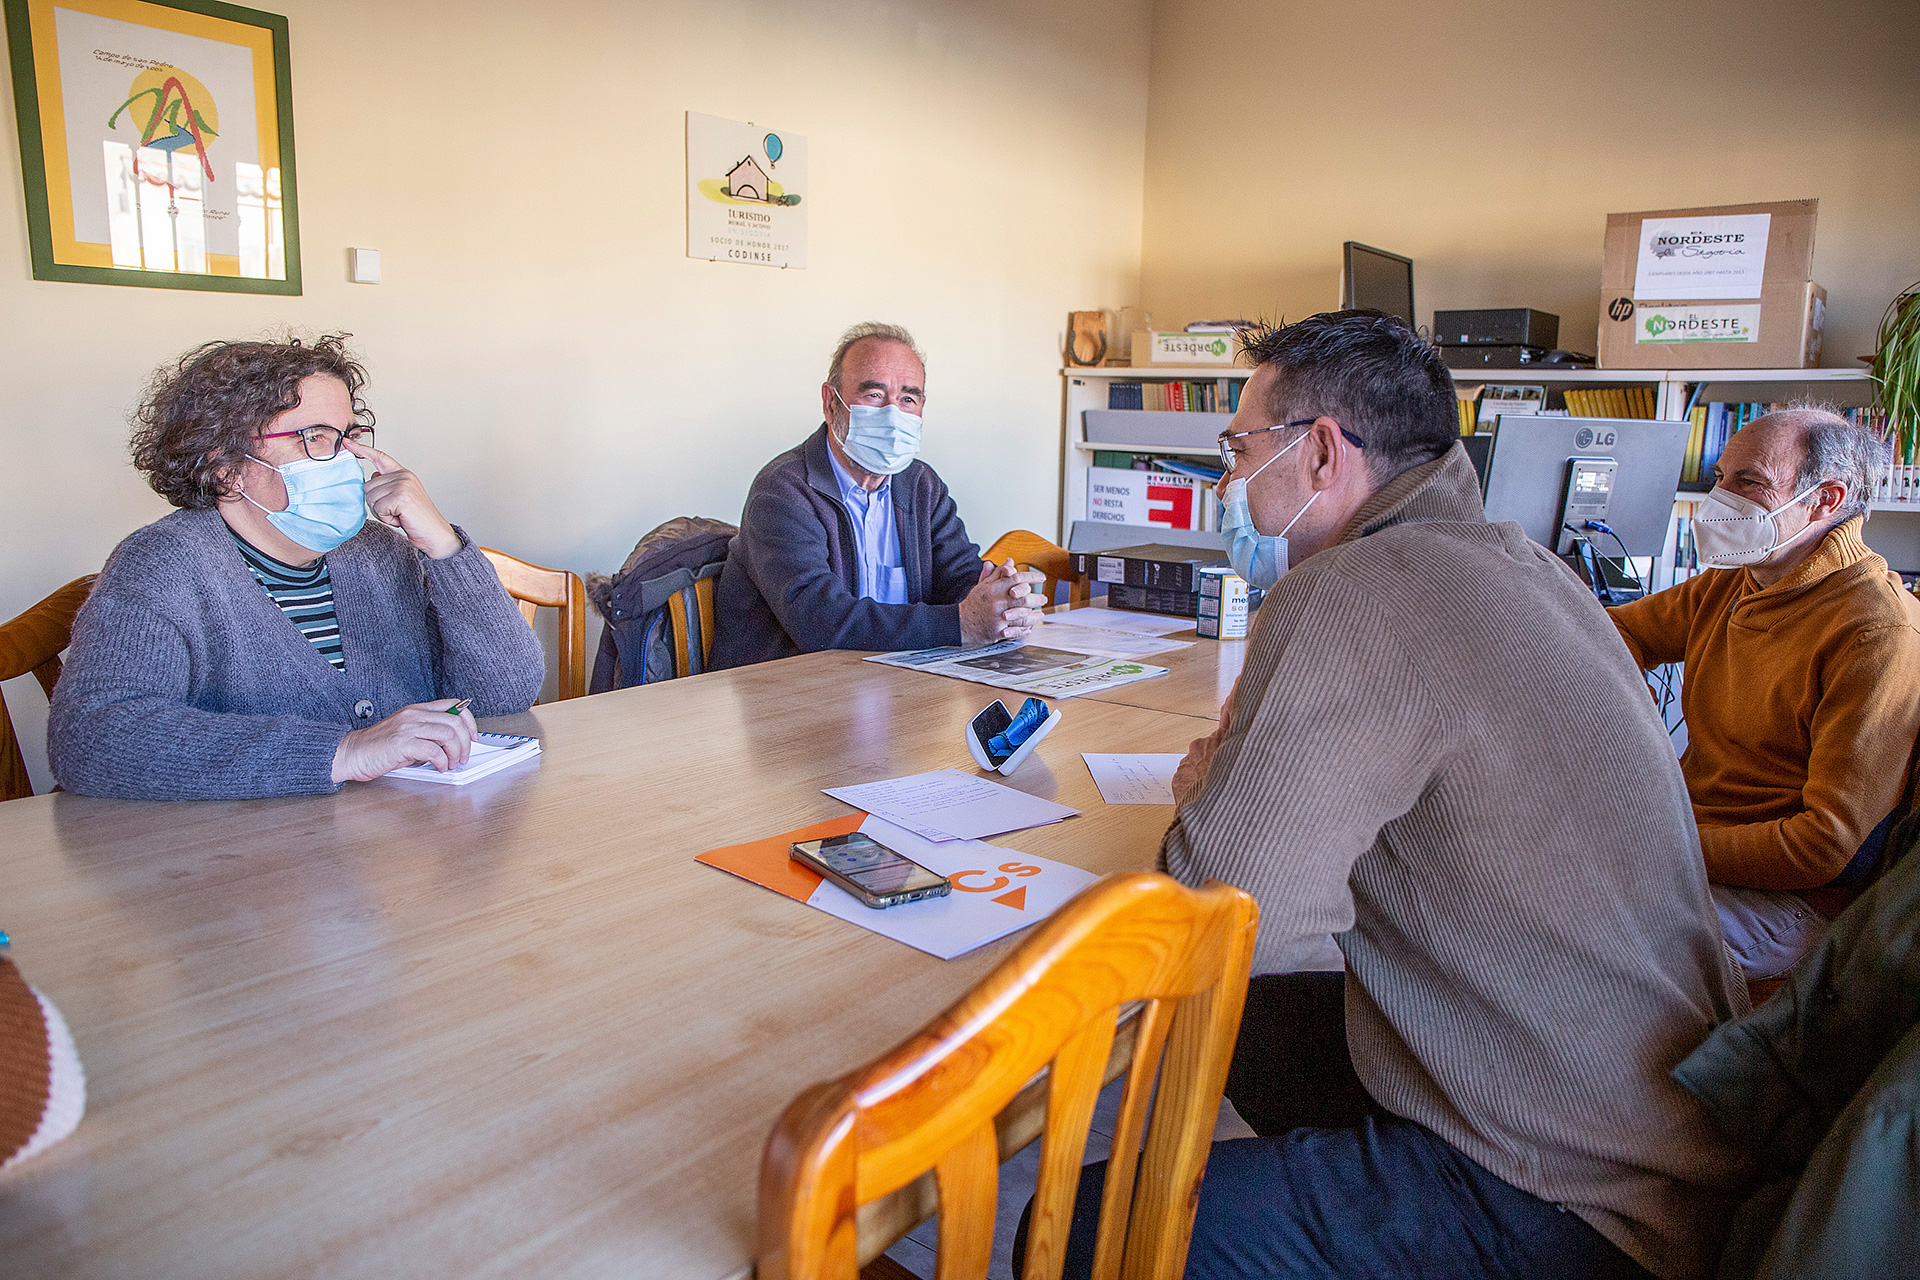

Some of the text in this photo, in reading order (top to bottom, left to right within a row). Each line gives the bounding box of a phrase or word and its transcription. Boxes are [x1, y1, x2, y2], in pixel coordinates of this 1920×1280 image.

[710, 236, 732, 244] SOCIO
[1657, 234, 1745, 245] NORDESTE
[728, 250, 771, 261] CODINSE
[1681, 245, 1745, 259] Segovia
[1611, 298, 1632, 321] hp
[1653, 318, 1739, 331] NORDESTE
[1164, 344, 1221, 352] NORDESTE
[1595, 432, 1615, 446] LG
[1147, 475, 1193, 484] REVUELTA
[1093, 485, 1130, 496] SER MENOS
[1093, 498, 1123, 508] NO RESTA
[1092, 511, 1125, 522] DERECHOS
